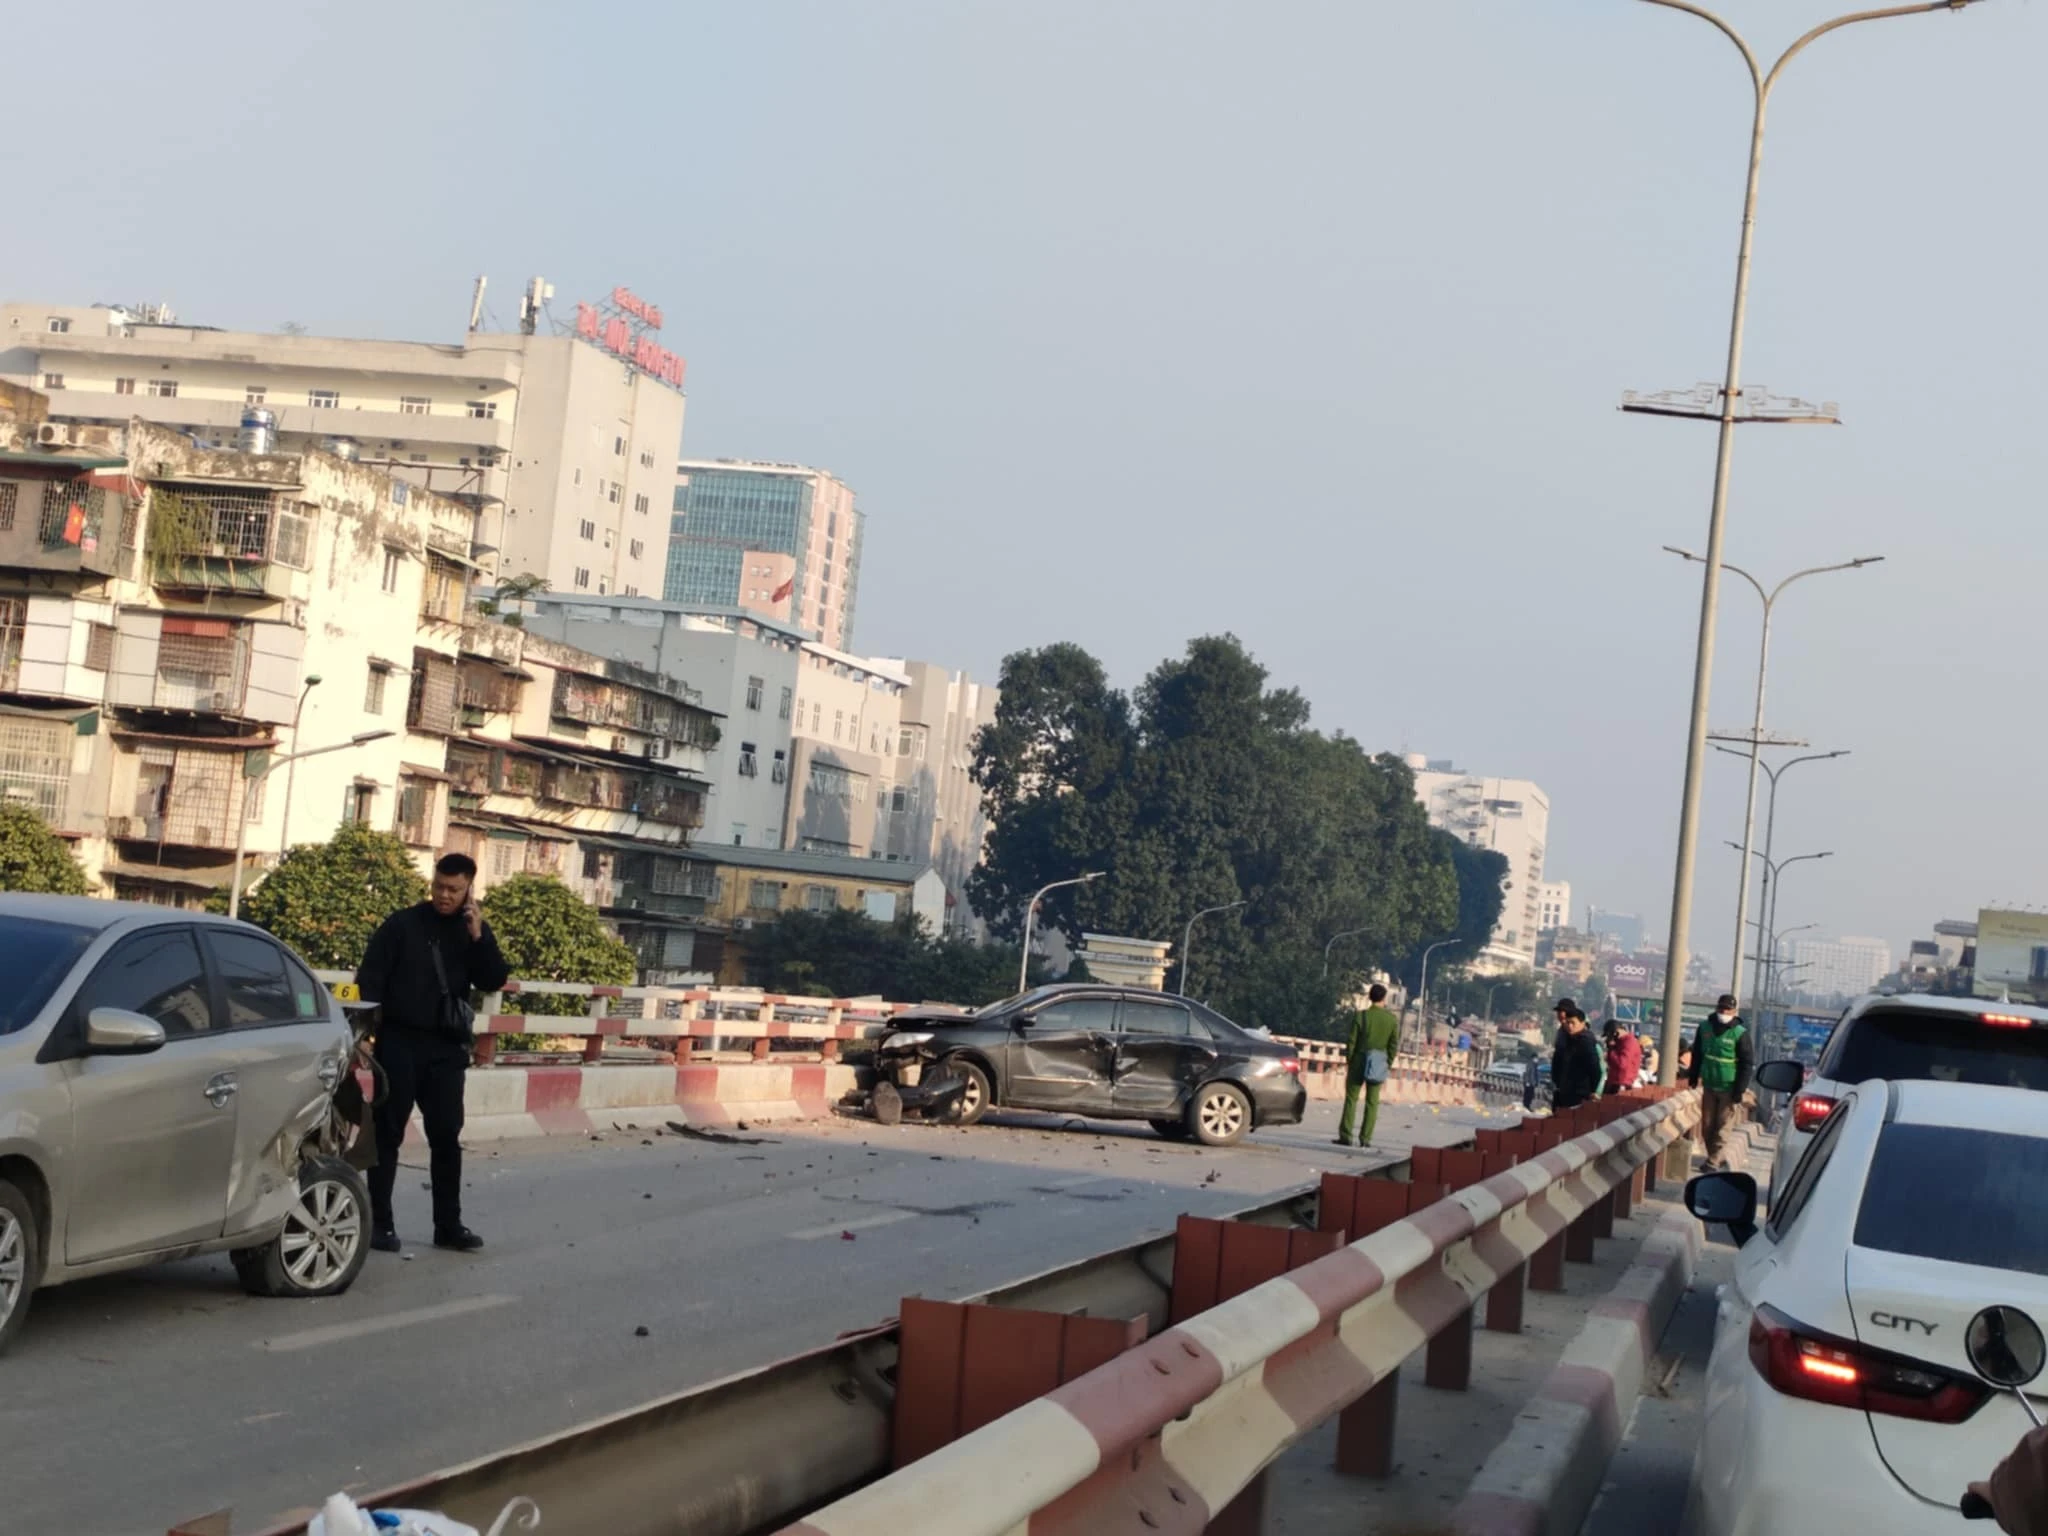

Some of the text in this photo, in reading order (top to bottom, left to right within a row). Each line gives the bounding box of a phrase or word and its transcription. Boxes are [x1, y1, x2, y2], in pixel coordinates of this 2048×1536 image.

[1614, 964, 1646, 976] odoo
[341, 986, 350, 998] 6
[1870, 1311, 1939, 1336] CITY
